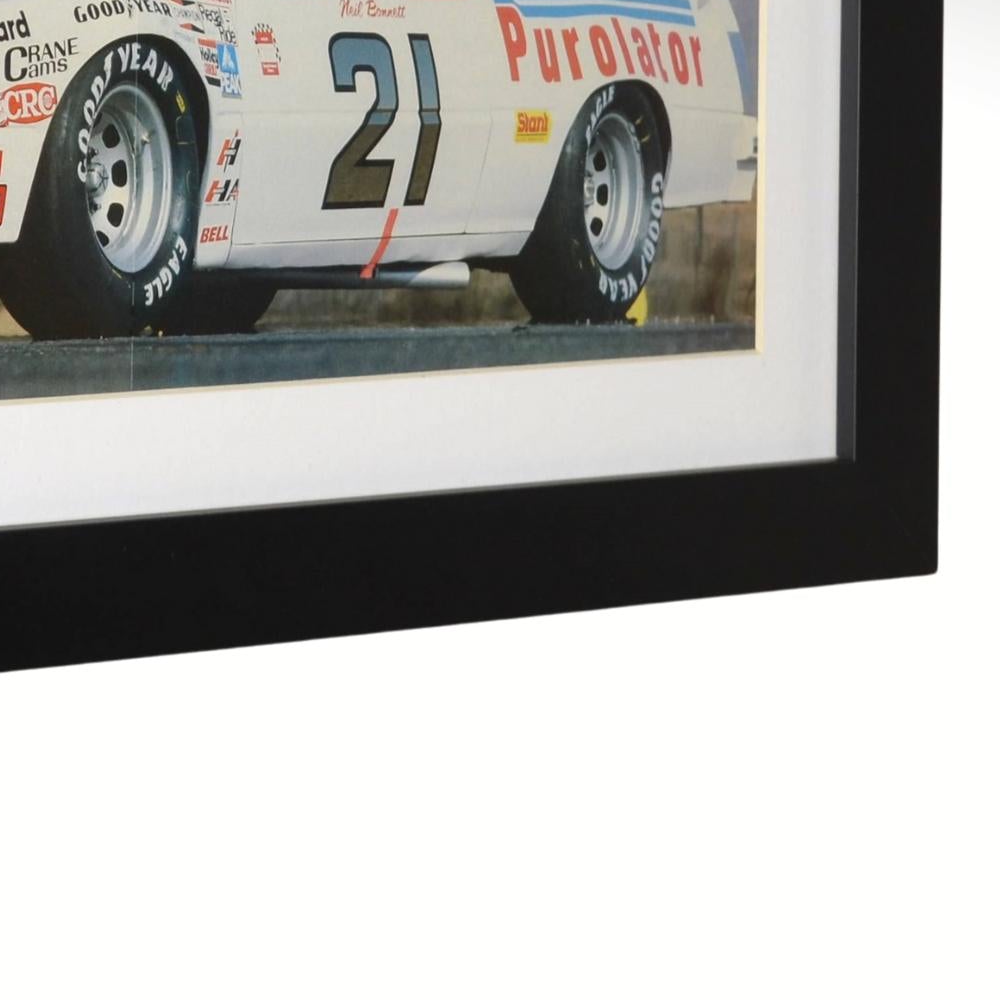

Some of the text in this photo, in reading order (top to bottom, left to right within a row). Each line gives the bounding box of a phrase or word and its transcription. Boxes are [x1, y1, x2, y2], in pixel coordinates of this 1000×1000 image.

[495, 6, 703, 87] Purolator
[4, 86, 58, 120] CRC
[321, 31, 442, 209] 21
[200, 225, 229, 243] BELL
[144, 235, 187, 306] EAGLE
